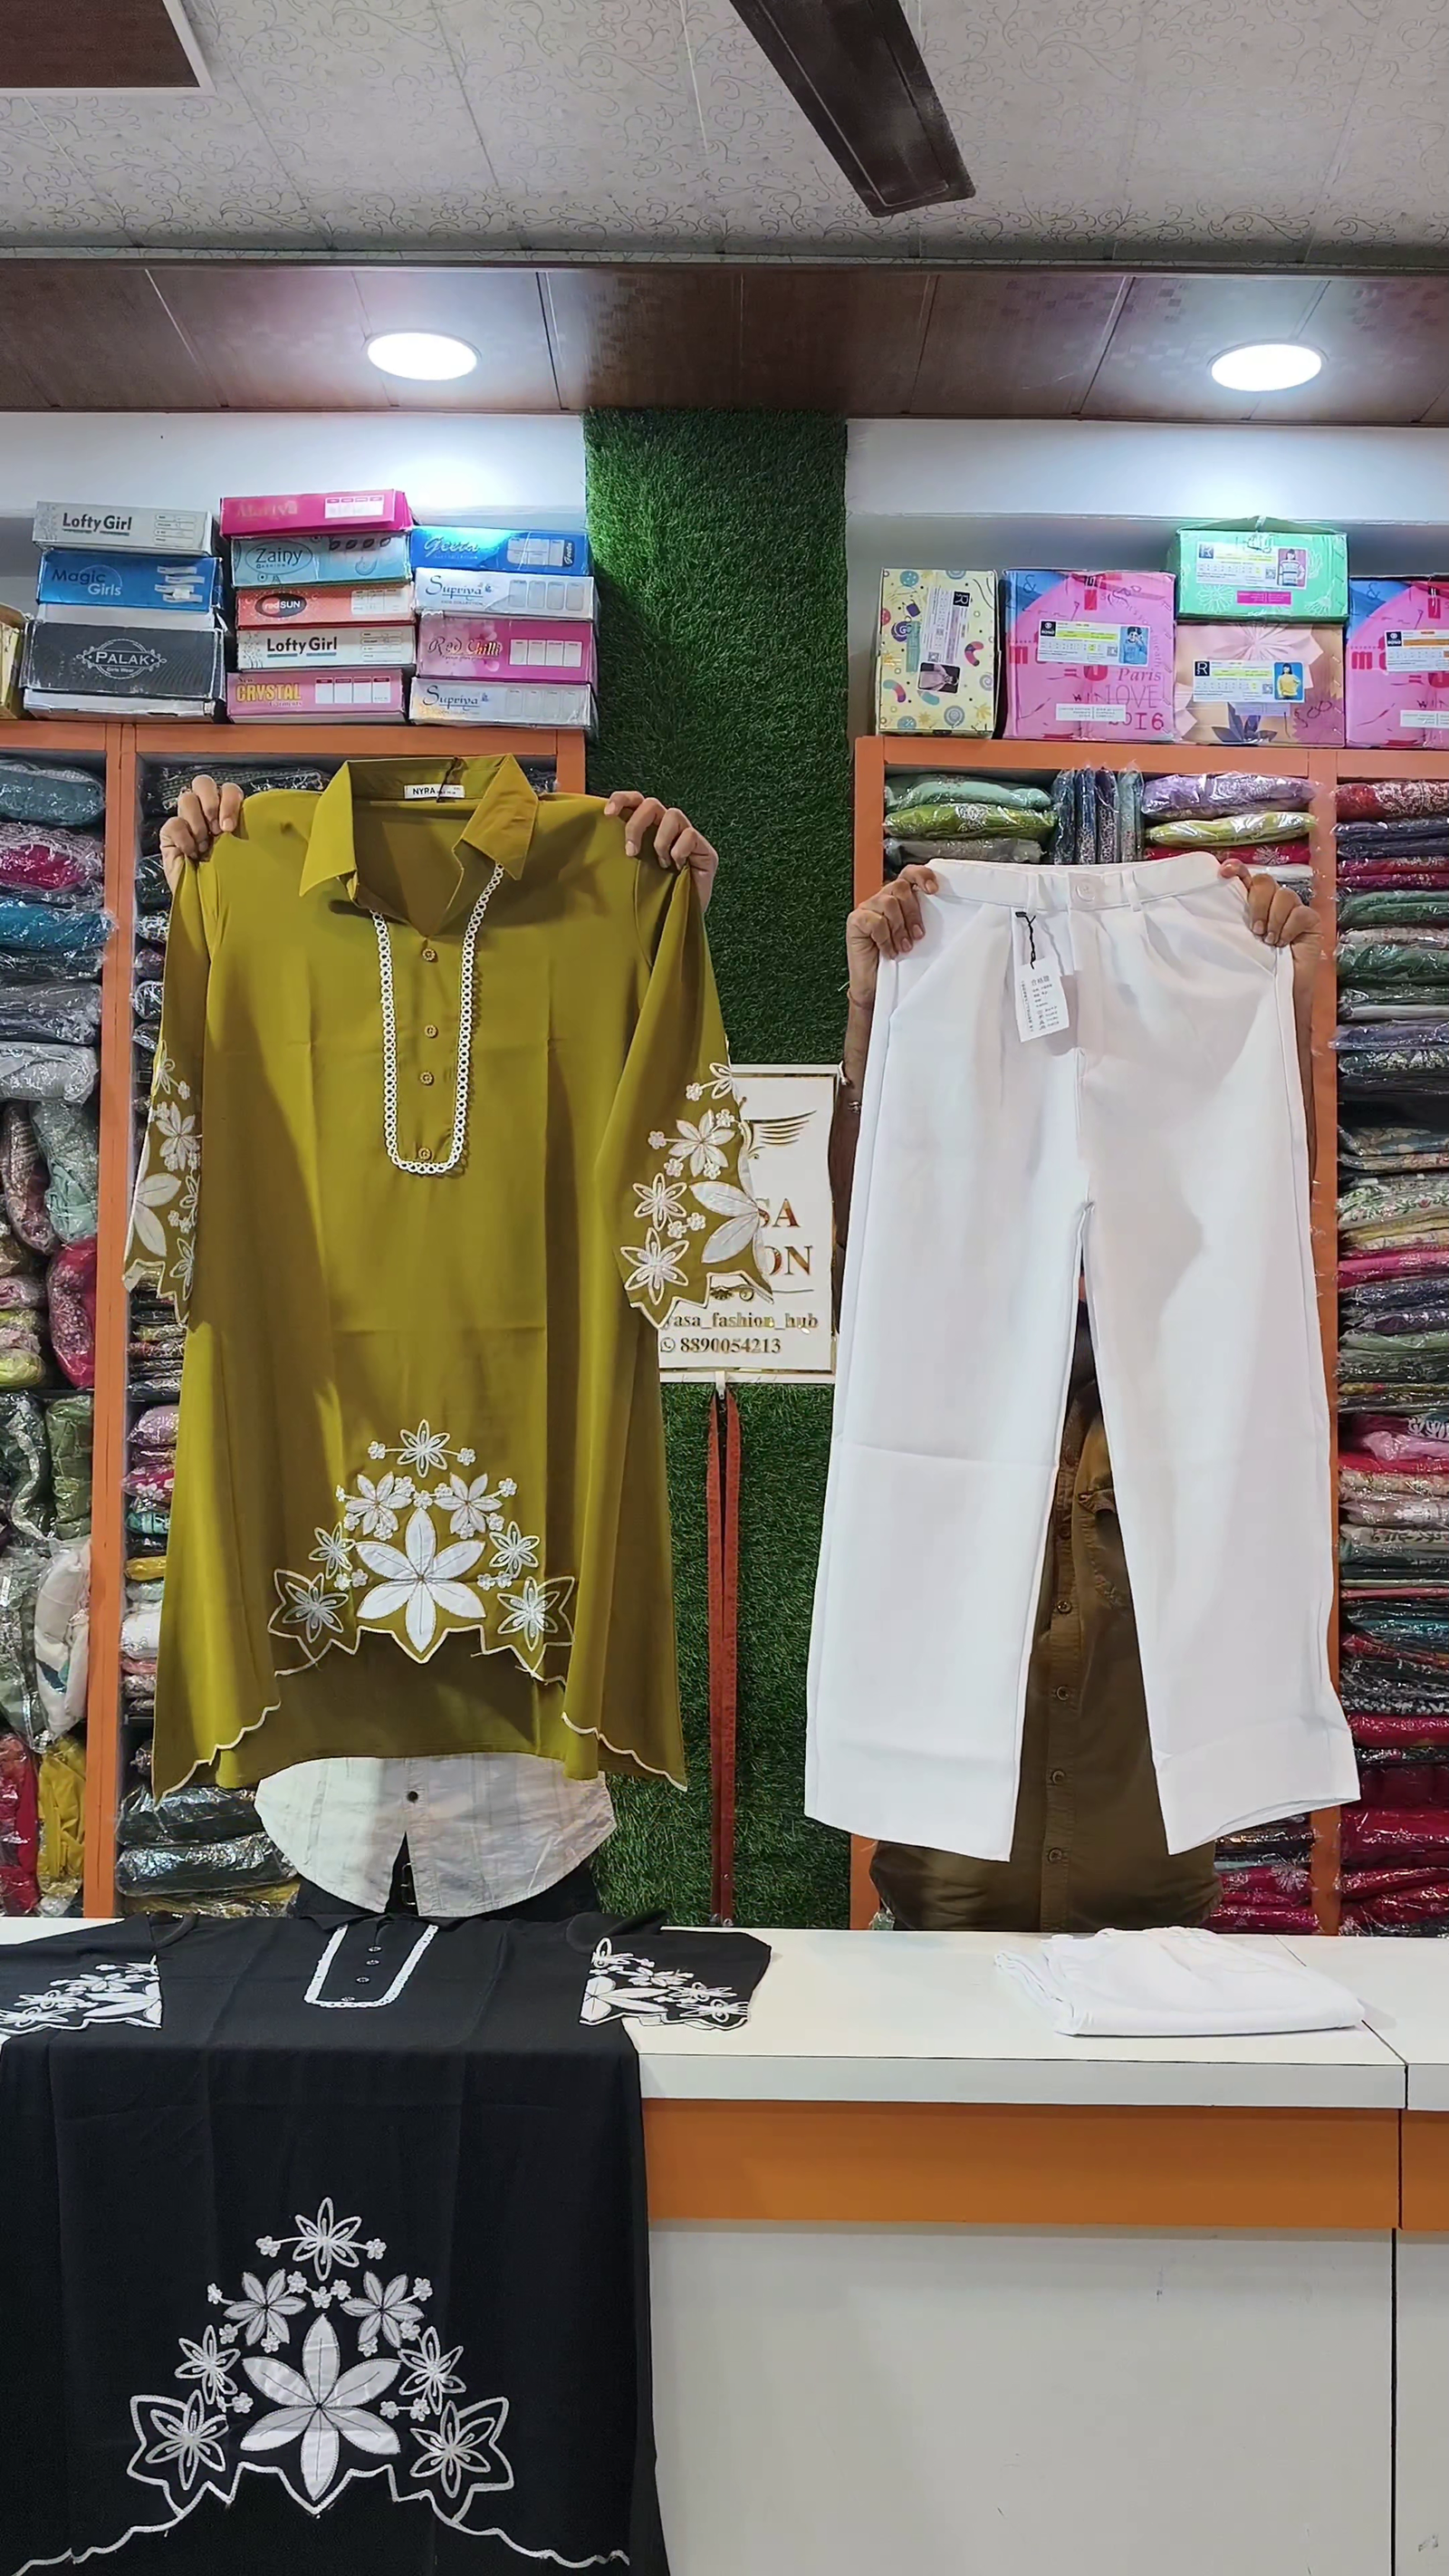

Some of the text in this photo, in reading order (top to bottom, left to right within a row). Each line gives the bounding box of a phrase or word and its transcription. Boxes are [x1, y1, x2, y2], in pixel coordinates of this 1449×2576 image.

[62, 513, 132, 532] Lofty Girl
[255, 547, 303, 566] Zainy
[53, 569, 106, 584] Magic
[88, 583, 121, 596] Girls
[426, 575, 482, 601] Supriya
[267, 637, 337, 654] Lofty Girl
[427, 636, 501, 655] Red Chilli
[96, 651, 149, 665] PALAK
[1118, 668, 1162, 681] Paris
[235, 683, 302, 702] CRYSTAL
[423, 685, 478, 711] Supriya
[413, 787, 435, 795] NYRA
[680, 1337, 782, 1354] 8890054213
